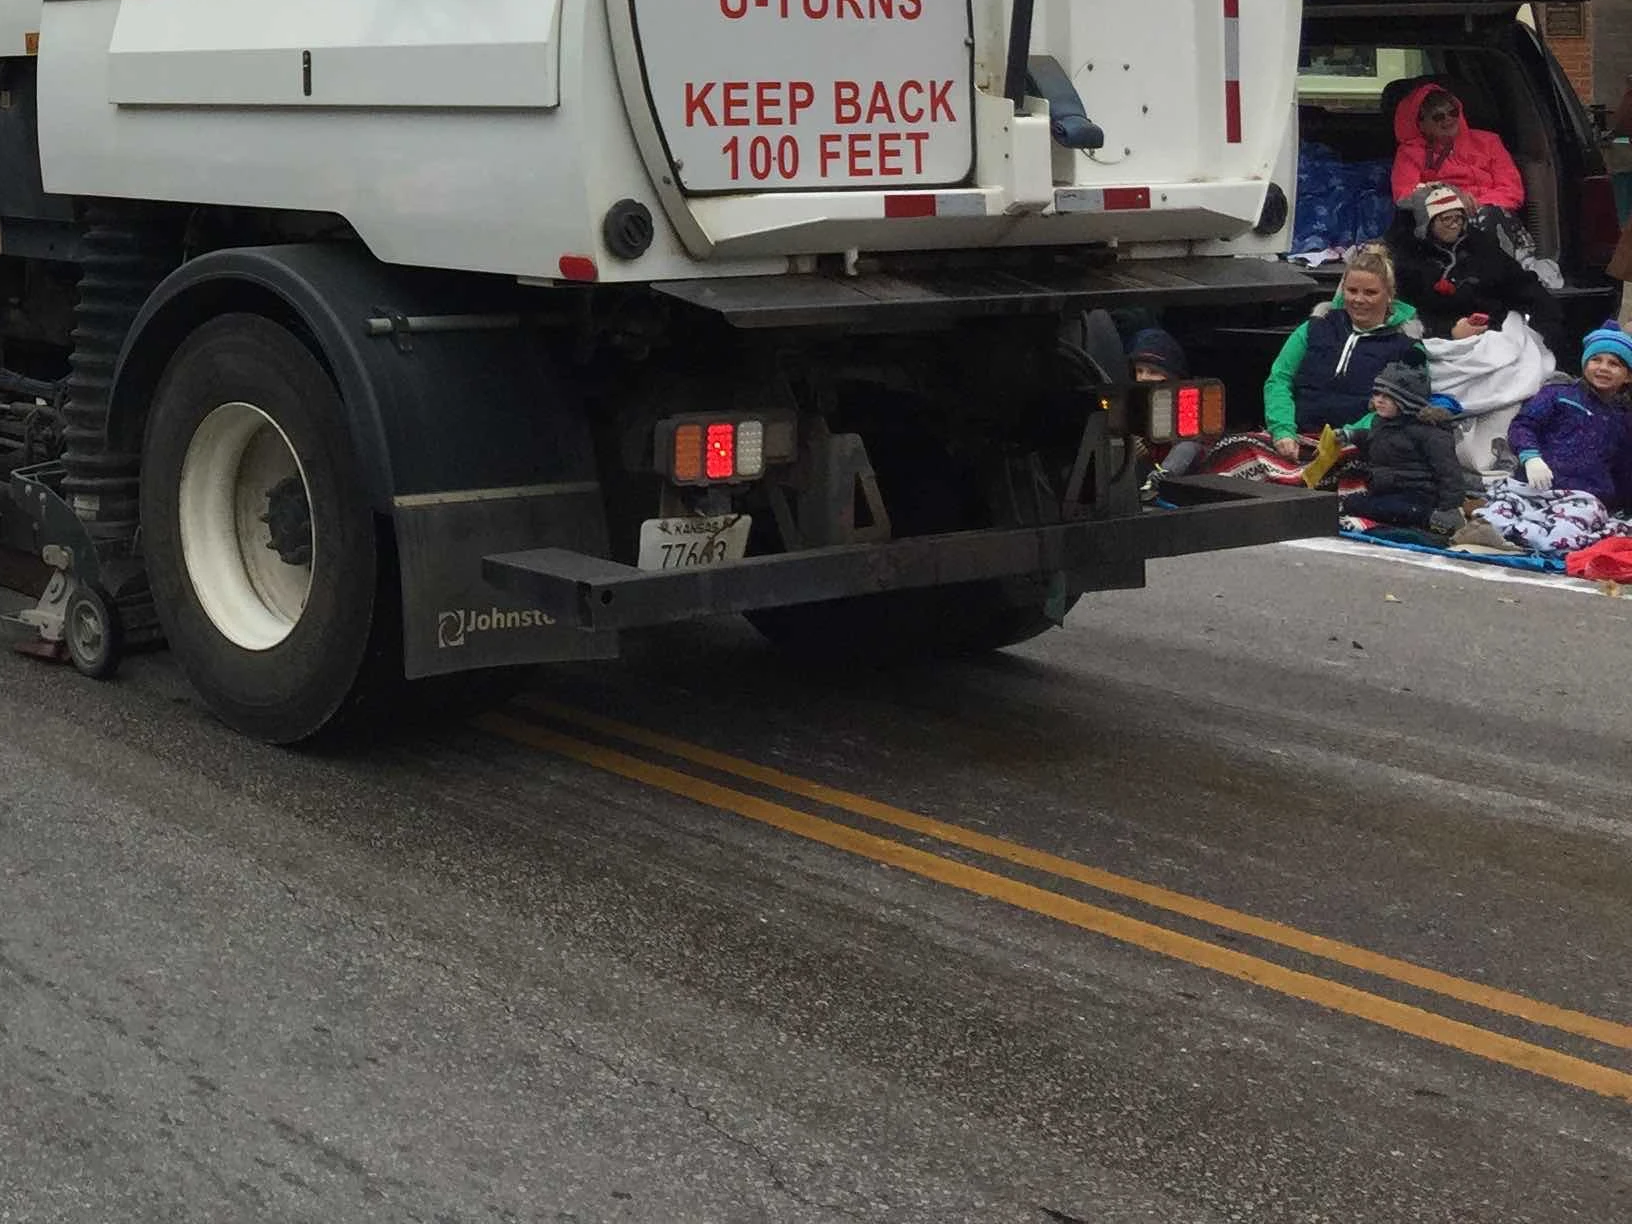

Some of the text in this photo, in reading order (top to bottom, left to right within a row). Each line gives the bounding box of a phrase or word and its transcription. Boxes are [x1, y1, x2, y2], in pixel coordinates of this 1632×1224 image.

[684, 79, 957, 127] KEEP BACK
[722, 132, 930, 180] 100 FEET
[674, 520, 720, 535] KANSAS
[466, 607, 556, 632] Johnsto
